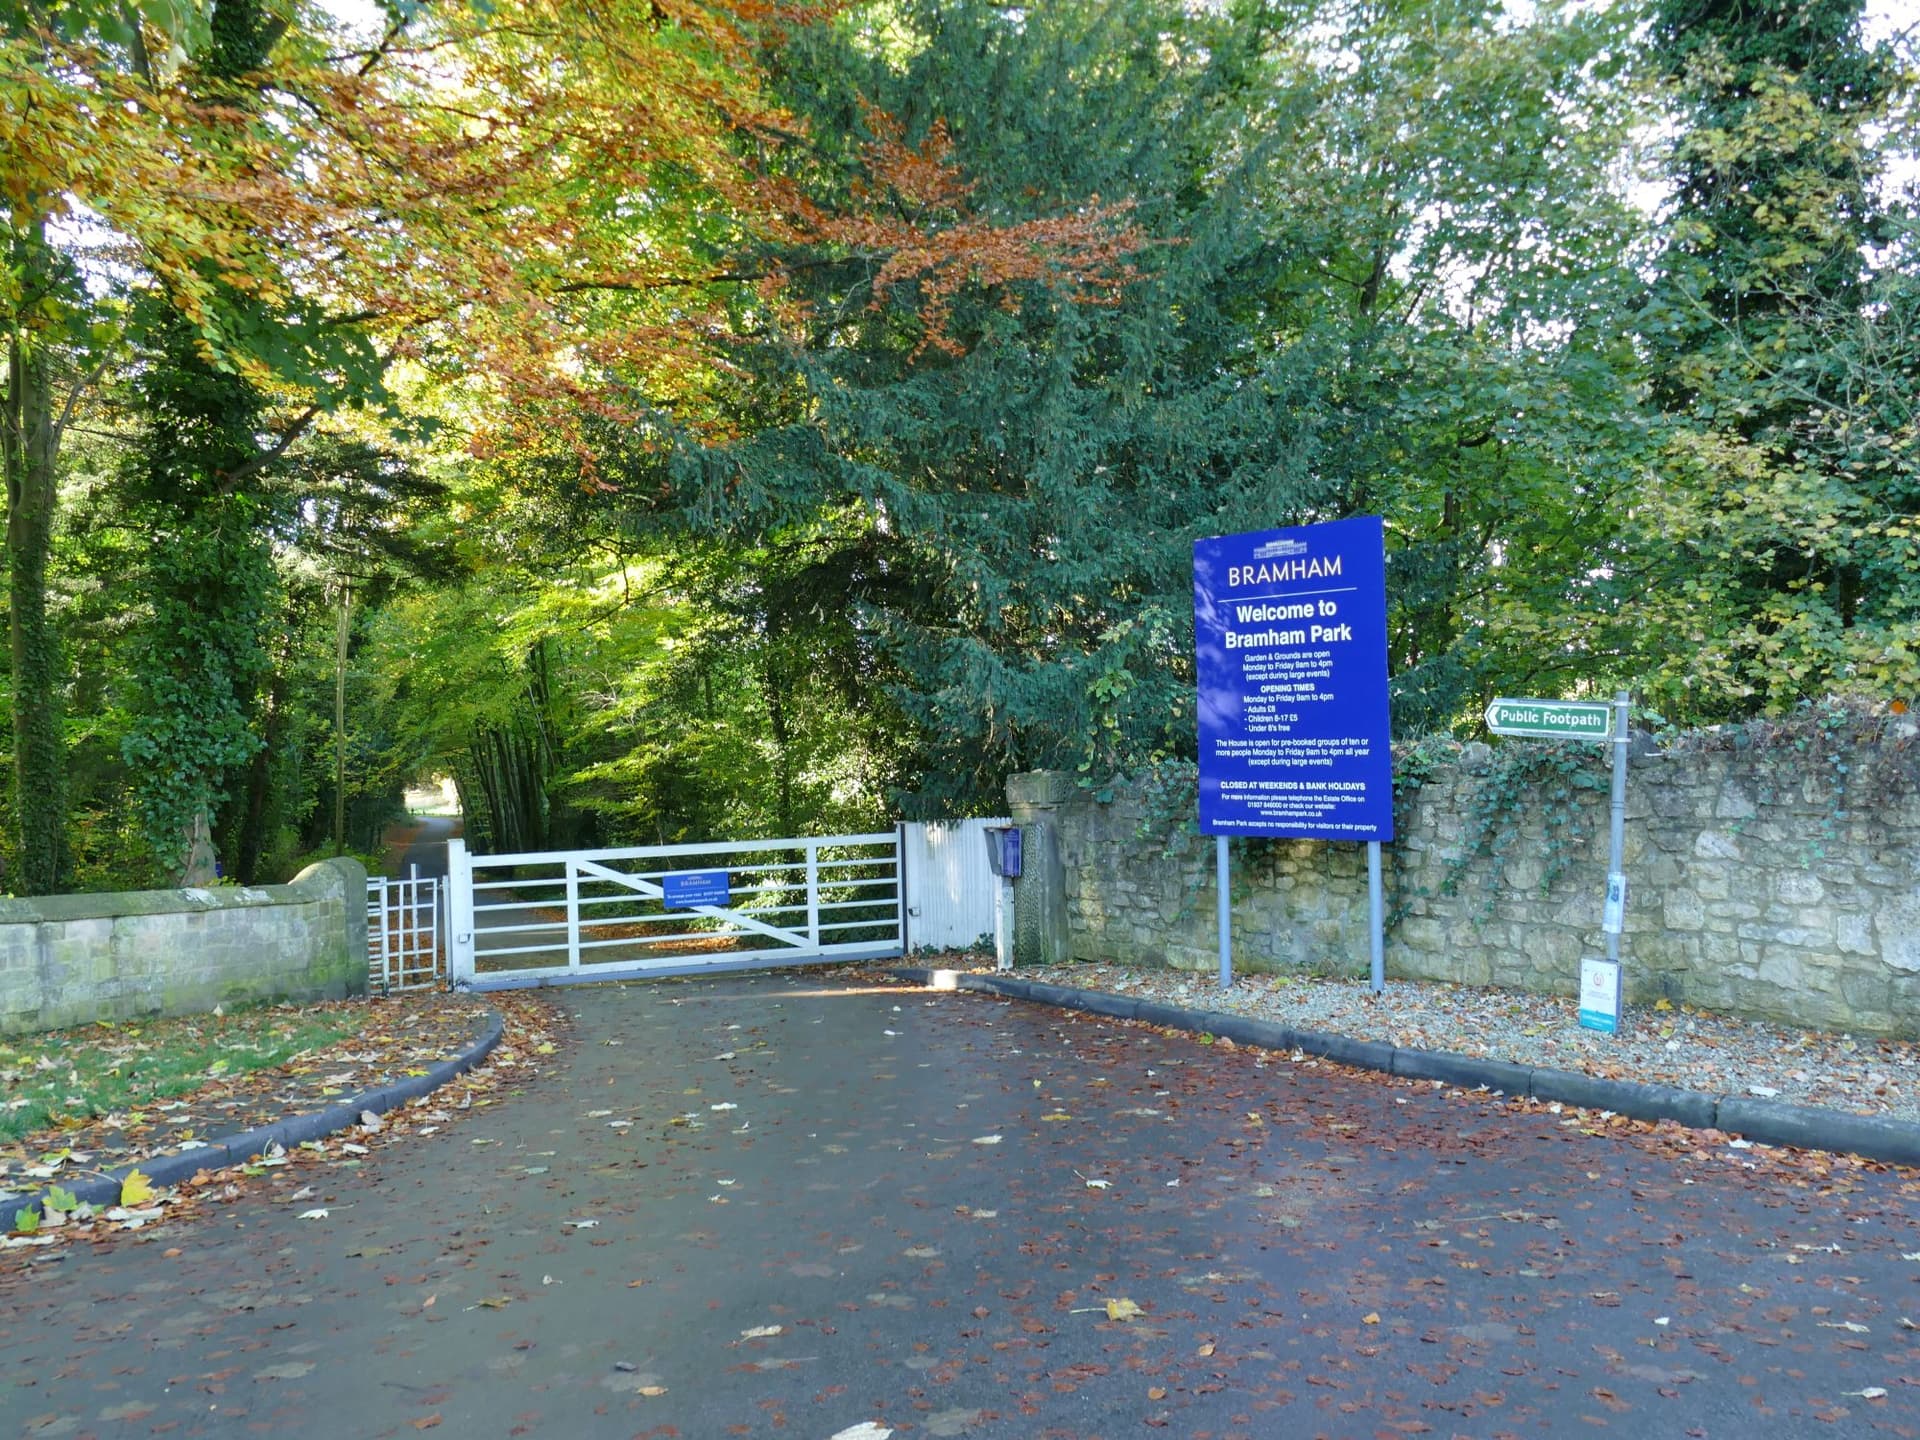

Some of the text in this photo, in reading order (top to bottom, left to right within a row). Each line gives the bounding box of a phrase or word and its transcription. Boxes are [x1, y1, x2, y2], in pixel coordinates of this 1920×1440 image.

[1229, 555, 1341, 587] BRAMHAM
[1236, 599, 1336, 623] Welcome to
[1225, 624, 1352, 648] Bramham Park
[1274, 652, 1301, 660] Grounds
[1318, 660, 1333, 668] 4pm
[1269, 672, 1288, 680] during
[1289, 671, 1305, 679] large
[1306, 669, 1330, 677] events)
[1260, 684, 1292, 693] OPENING
[1276, 695, 1295, 703] Friday
[1319, 693, 1334, 701] 4pm
[1501, 710, 1600, 728] Public Footpath
[1281, 738, 1316, 746] pre-booked
[1317, 739, 1340, 747] groups
[1232, 749, 1251, 758] people
[1252, 749, 1276, 757] Monday
[1285, 748, 1304, 756] Friday
[1248, 758, 1332, 767] (except during large events)
[1259, 781, 1298, 790] WEEKENDS
[1328, 782, 1366, 790] HOLIDAYS
